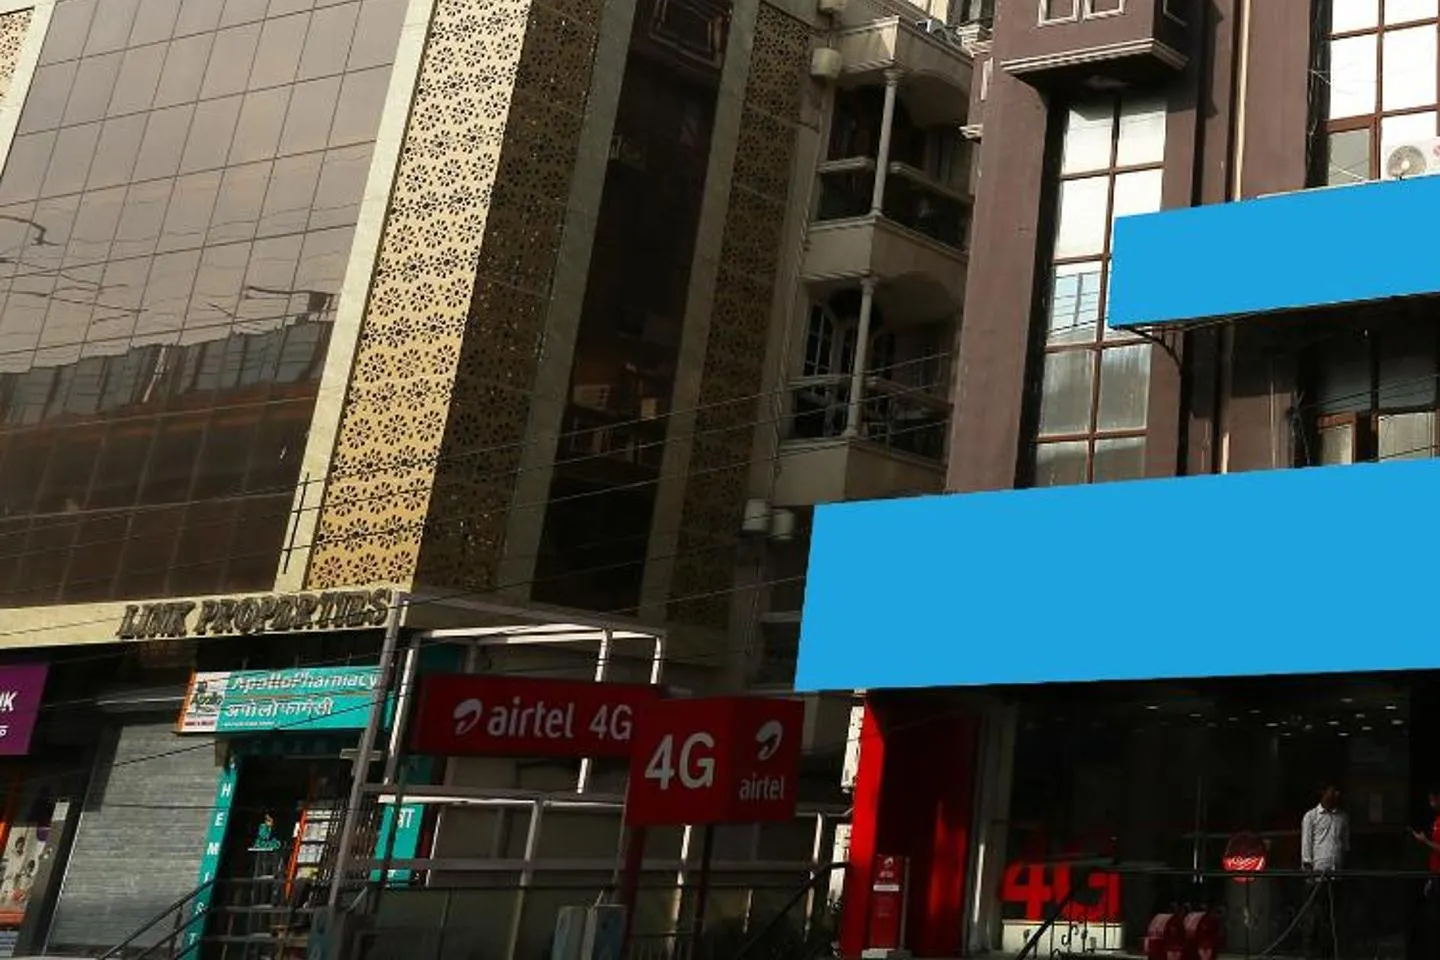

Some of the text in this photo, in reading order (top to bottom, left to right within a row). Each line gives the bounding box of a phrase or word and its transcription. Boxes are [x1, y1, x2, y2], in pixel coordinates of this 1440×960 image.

[116, 587, 392, 640] LINK PROPERTIES
[487, 695, 633, 741] airtel 4G
[644, 732, 716, 790] 4G
[738, 772, 785, 802] airtel
